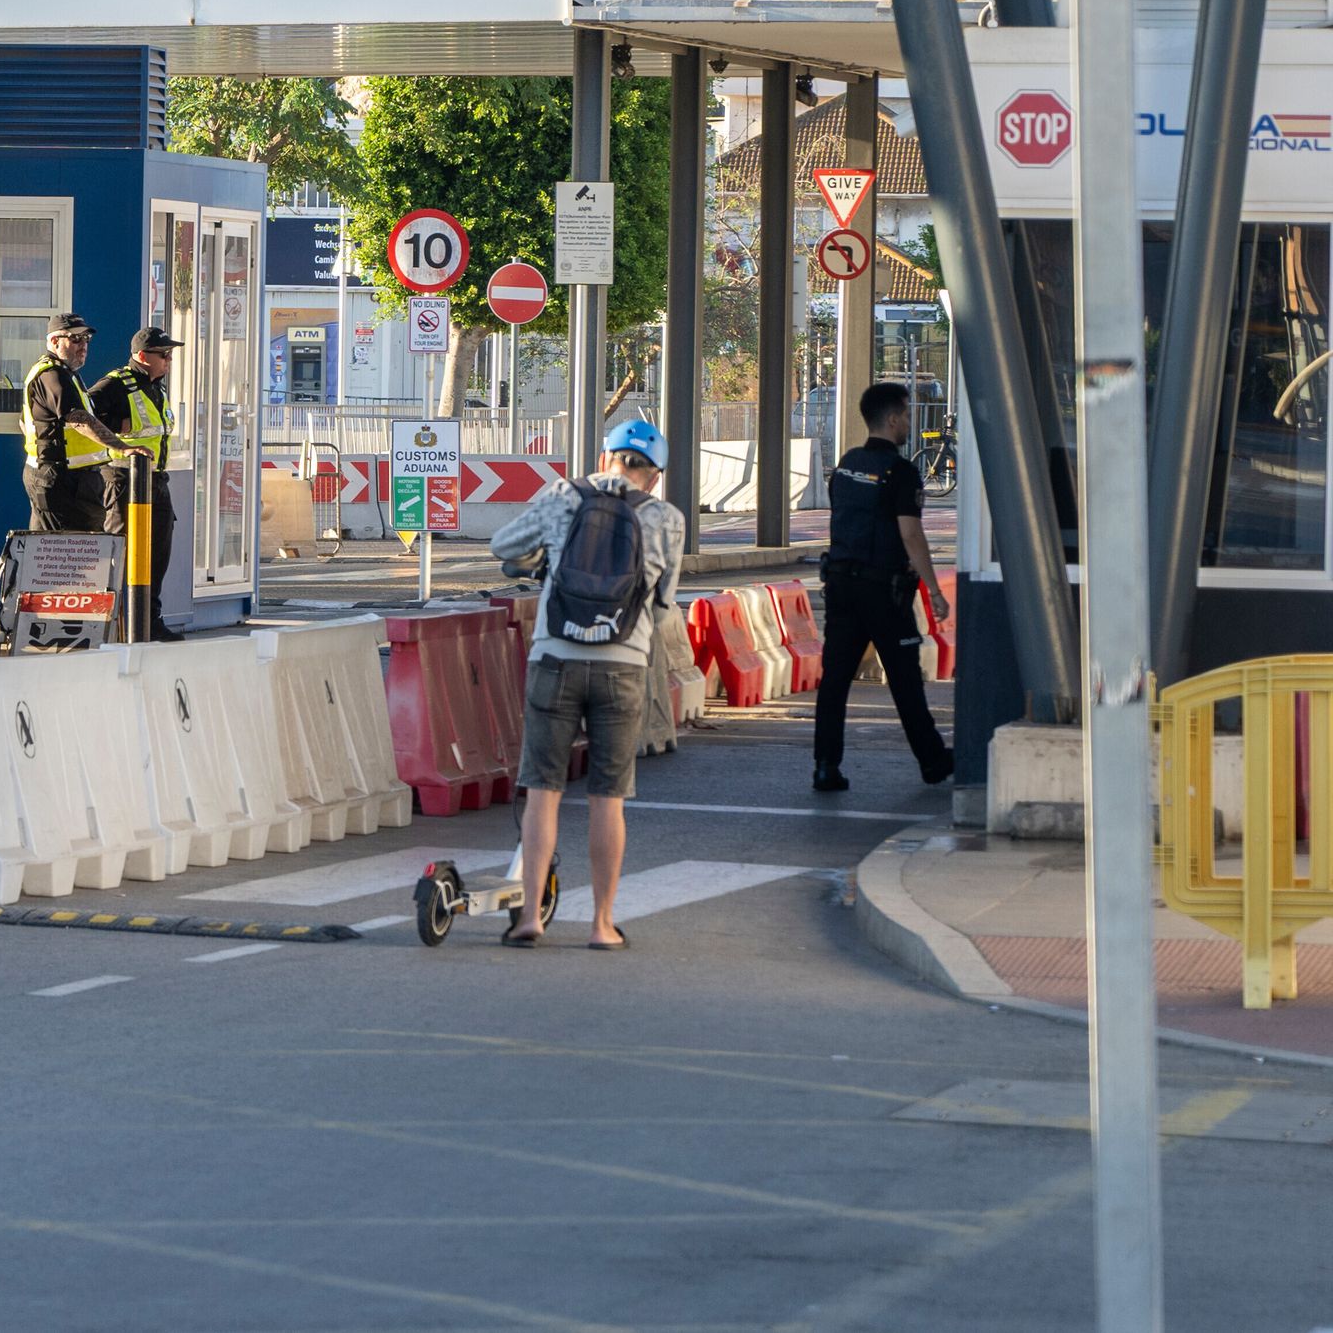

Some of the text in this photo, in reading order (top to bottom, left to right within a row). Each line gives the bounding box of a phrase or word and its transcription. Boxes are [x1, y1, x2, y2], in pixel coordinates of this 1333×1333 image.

[1004, 112, 1069, 145] STOP
[827, 177, 862, 189] GIVE
[835, 192, 856, 200] WAY
[404, 232, 453, 269] 10
[413, 300, 446, 308] NO IDLING
[294, 330, 319, 338] ATM
[395, 451, 457, 461] CUSTOMS
[403, 464, 448, 473] ADUANA
[40, 537, 66, 545] Operation
[45, 555, 66, 563] Parking
[67, 555, 99, 563] Restrictions
[50, 579, 71, 587] respect
[41, 595, 92, 608] STOP
